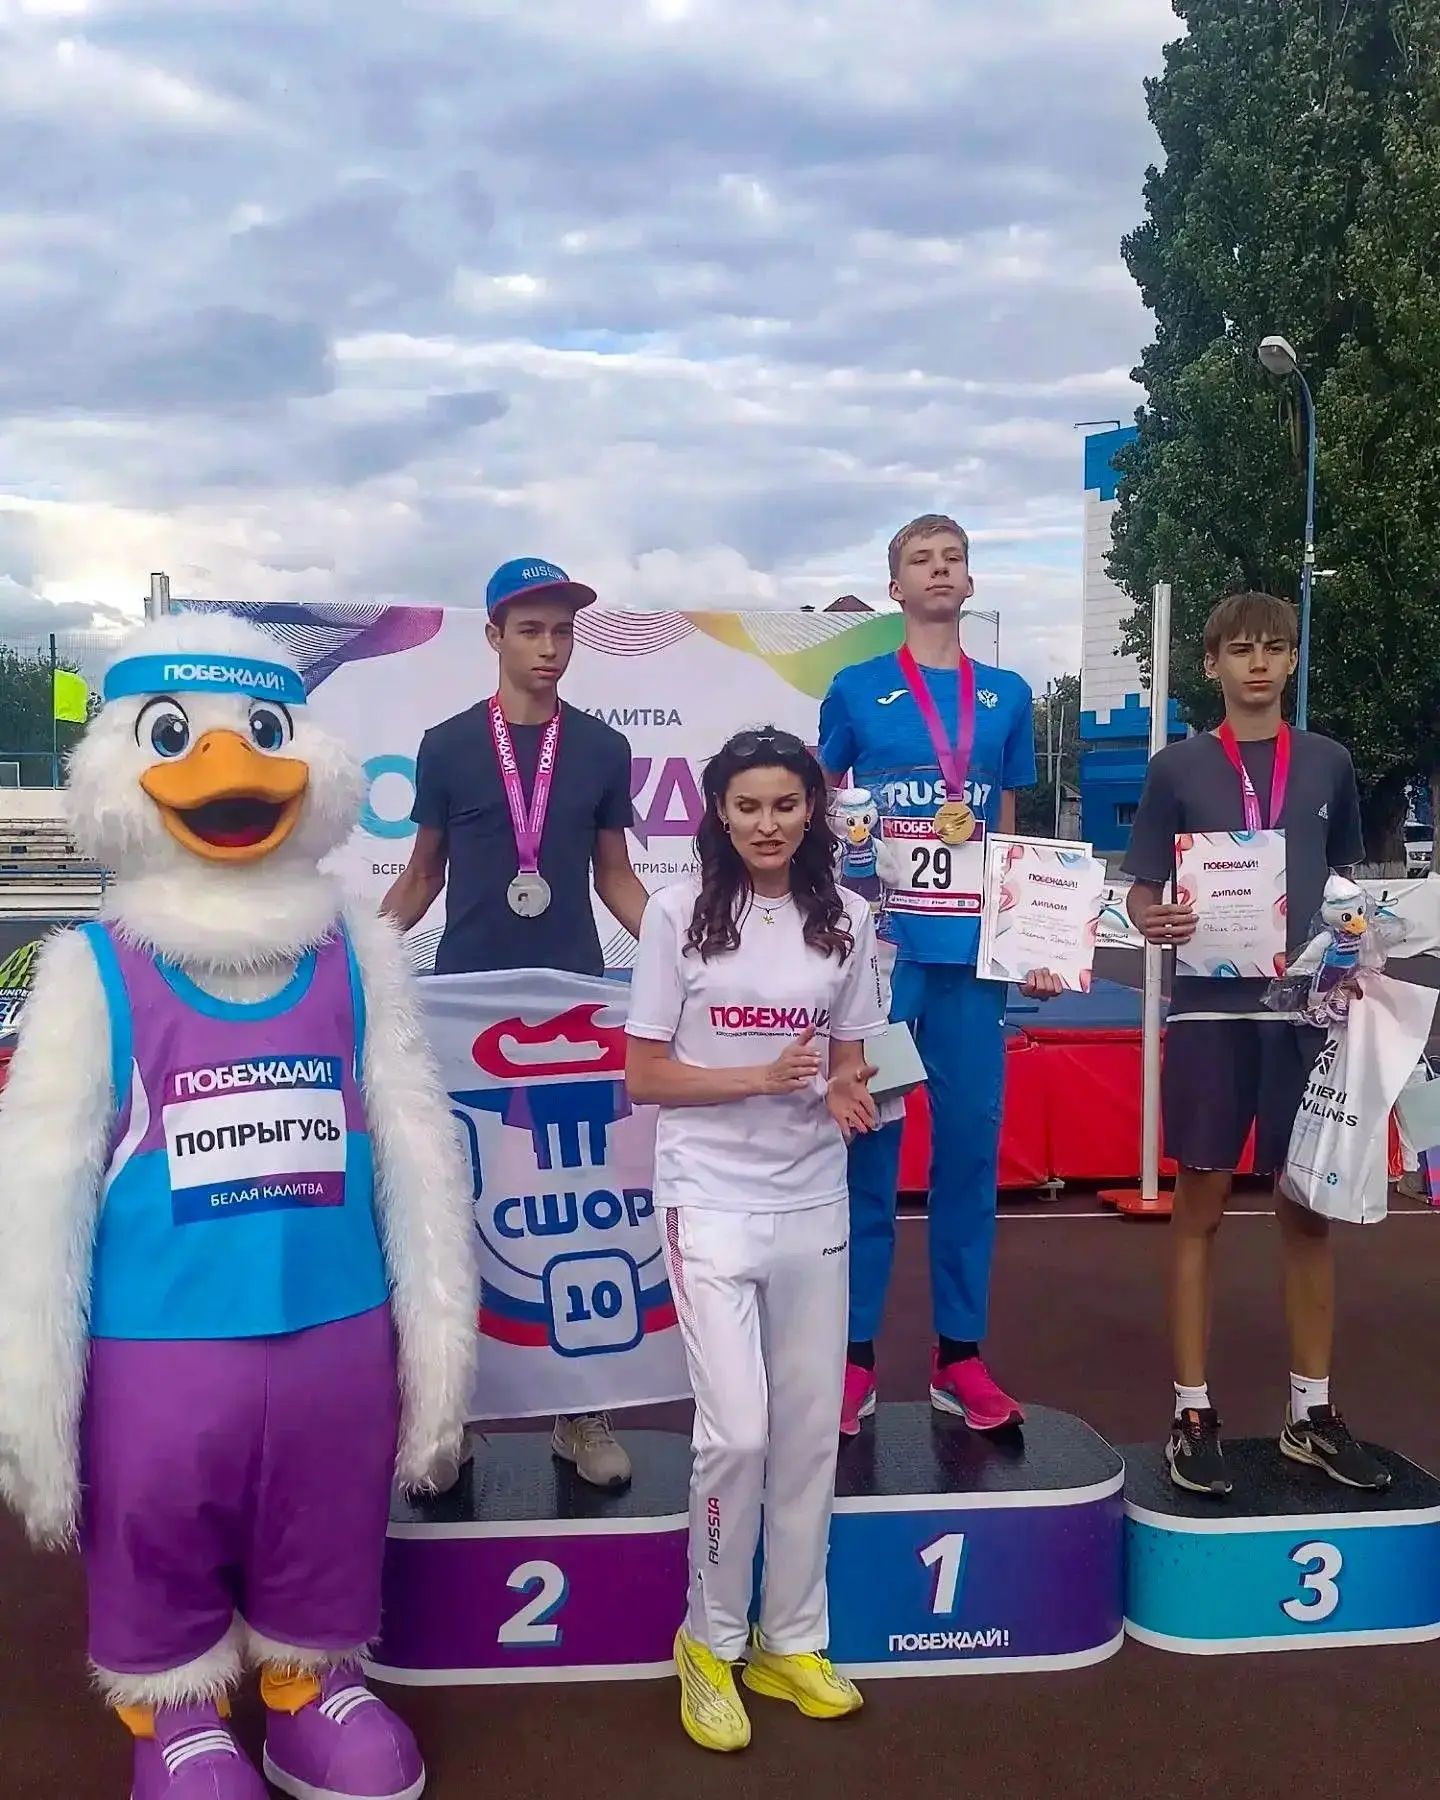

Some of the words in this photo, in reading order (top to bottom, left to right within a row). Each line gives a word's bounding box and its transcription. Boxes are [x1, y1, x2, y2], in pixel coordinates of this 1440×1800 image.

[163, 663, 285, 691] ПОБЕЖДАЙ!
[585, 708, 682, 726] АЛИТВА
[911, 846, 952, 890] 29
[1031, 899, 1068, 911] ДИПЛОМ
[1211, 888, 1252, 898] ДИПЛОМ
[174, 1057, 333, 1097] ПОБЕЖДАЙ!
[175, 1118, 341, 1157] ПОПРЫГУСЬ
[210, 1187, 259, 1207] БЕЛАЯ
[263, 1182, 324, 1199] КАЛИТВА
[493, 1187, 655, 1239] СШОР
[565, 1280, 623, 1323] 10
[708, 1497, 720, 1565] RUSSIA
[919, 1533, 965, 1615] 1
[1283, 1541, 1343, 1623] 3
[497, 1560, 567, 1644] 2
[888, 1628, 1010, 1652] ПОБЕЖДАЙ!
